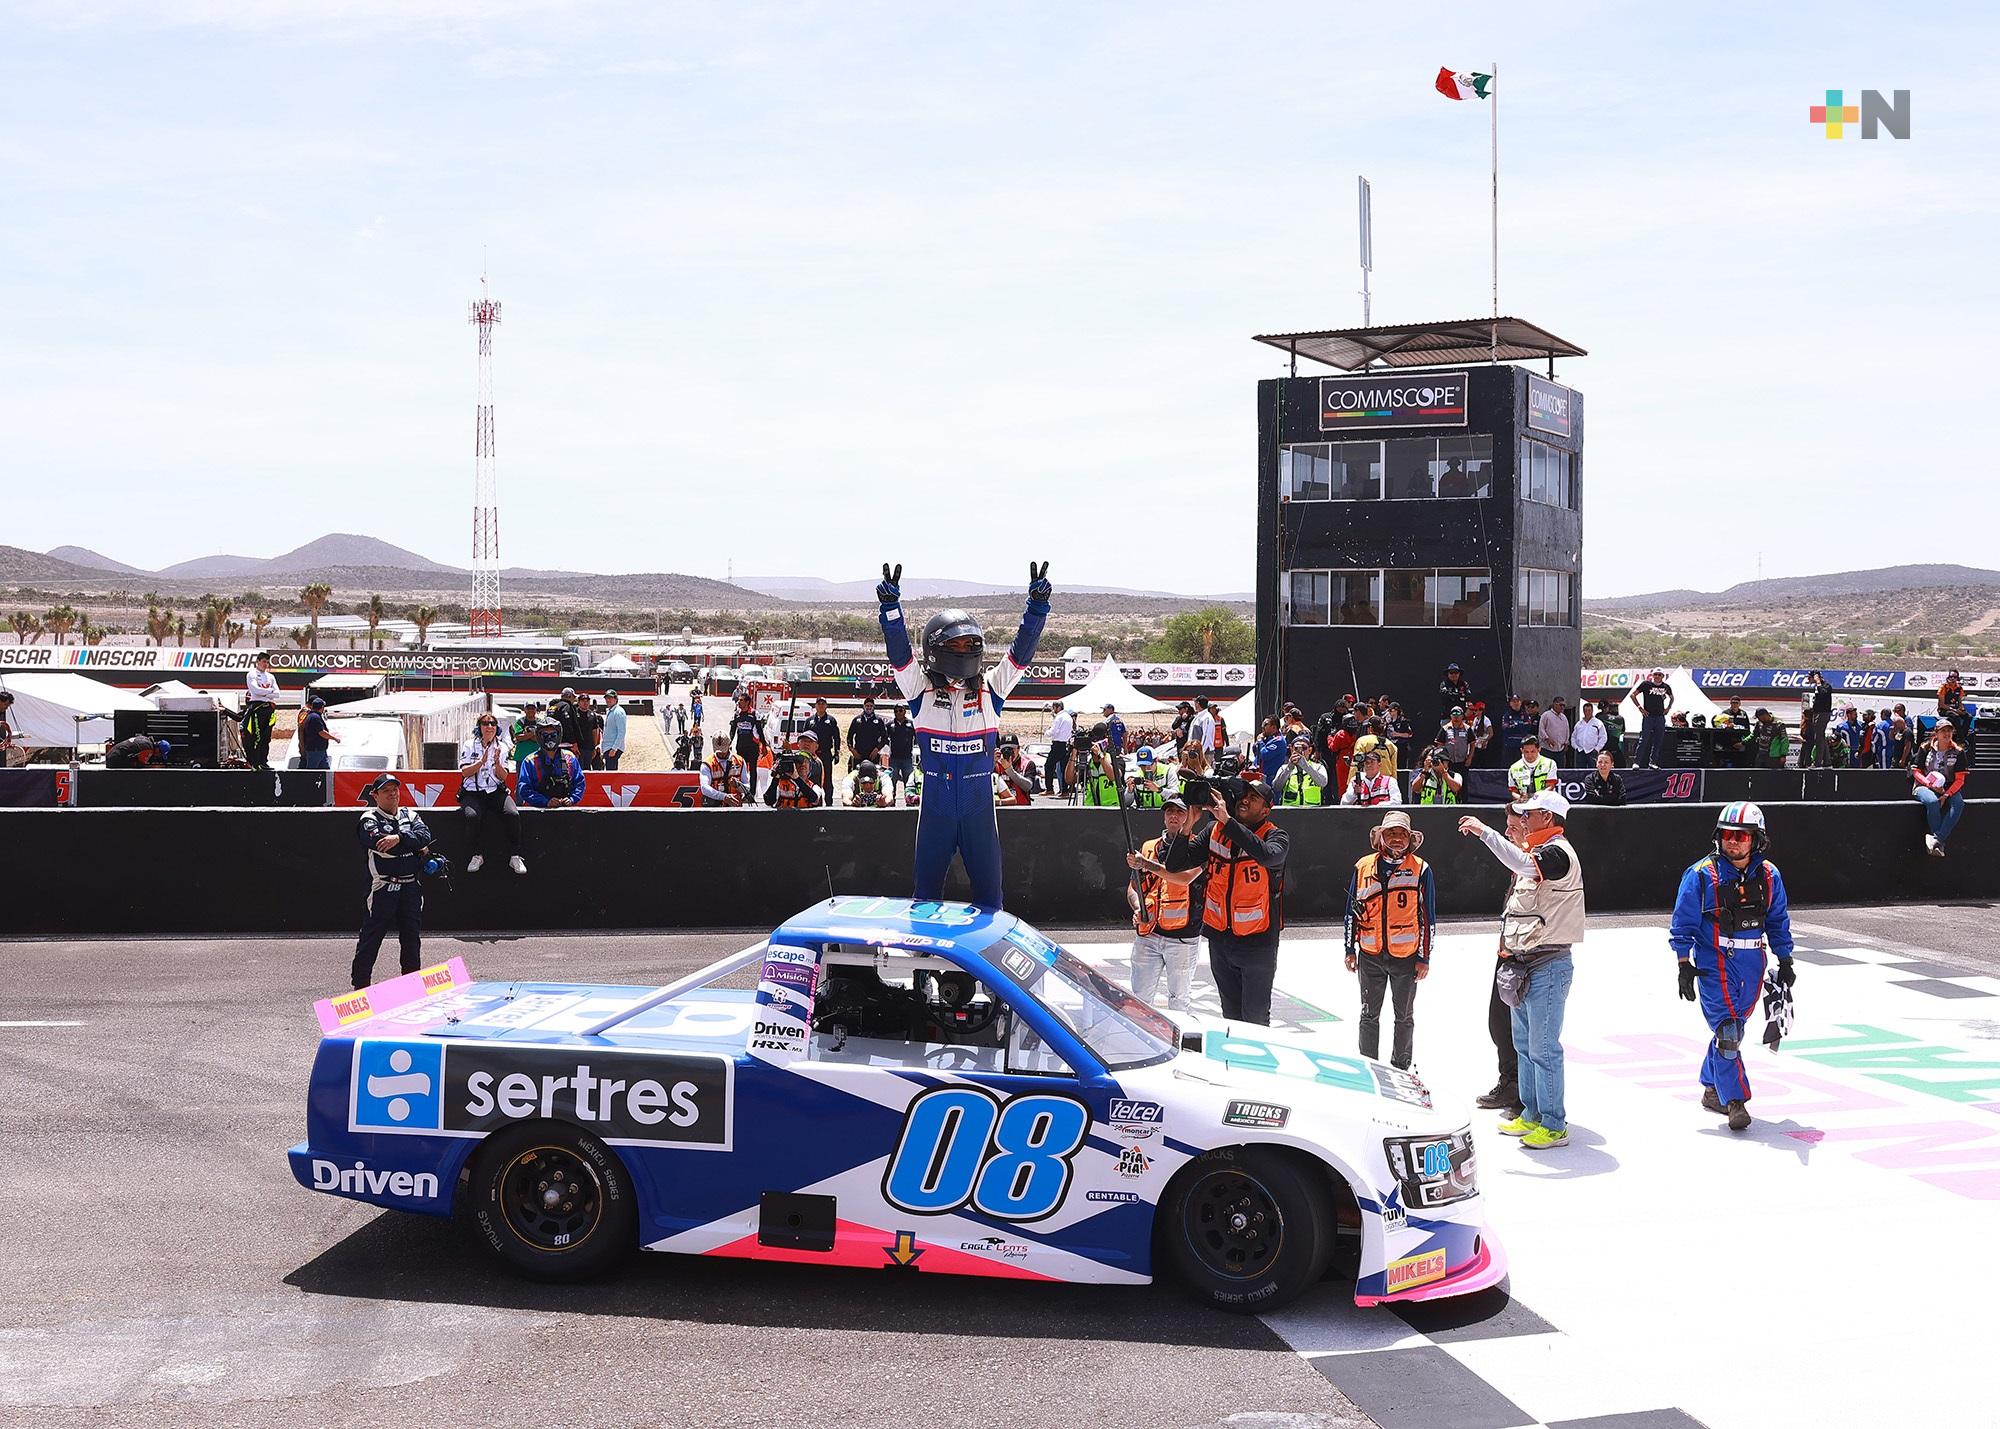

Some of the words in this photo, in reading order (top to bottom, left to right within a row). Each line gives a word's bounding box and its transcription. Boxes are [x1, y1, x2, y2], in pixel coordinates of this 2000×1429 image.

[86, 651, 157, 667] NASCAR
[1701, 670, 1750, 687] telcel
[1842, 671, 1893, 688] telcel
[945, 742, 981, 752] sertres
[1662, 772, 1696, 799] 10
[1242, 866, 1261, 884] 15
[1397, 892, 1408, 909] 9
[754, 1021, 805, 1039] Driven
[465, 1065, 699, 1129] sertres
[1111, 1101, 1161, 1121] telcel
[1235, 1103, 1283, 1120] TRUCKS
[882, 1084, 1092, 1223] 08
[1423, 1141, 1451, 1177] 08
[312, 1158, 439, 1199] Driven
[1089, 1191, 1138, 1202] RENTABLE
[960, 1242, 993, 1251] EAGLE
